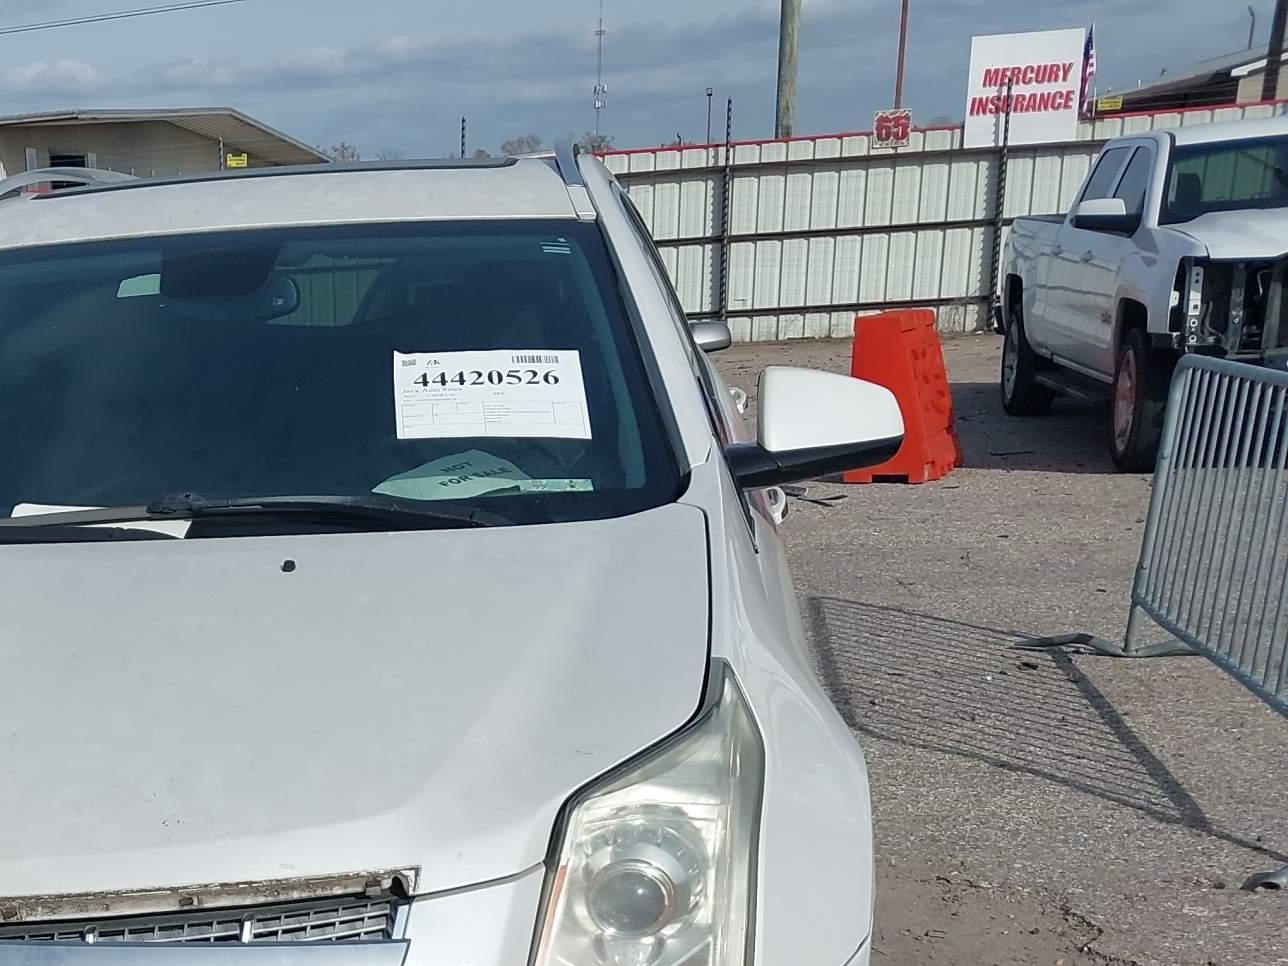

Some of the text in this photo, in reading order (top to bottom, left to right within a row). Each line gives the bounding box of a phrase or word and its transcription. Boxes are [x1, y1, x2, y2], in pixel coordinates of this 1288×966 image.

[982, 62, 1074, 88] MERCURY
[969, 90, 1075, 117] INSURANCE
[412, 369, 560, 387] 44420526
[438, 466, 513, 488] FOR SALE
[440, 460, 473, 475] NOT
